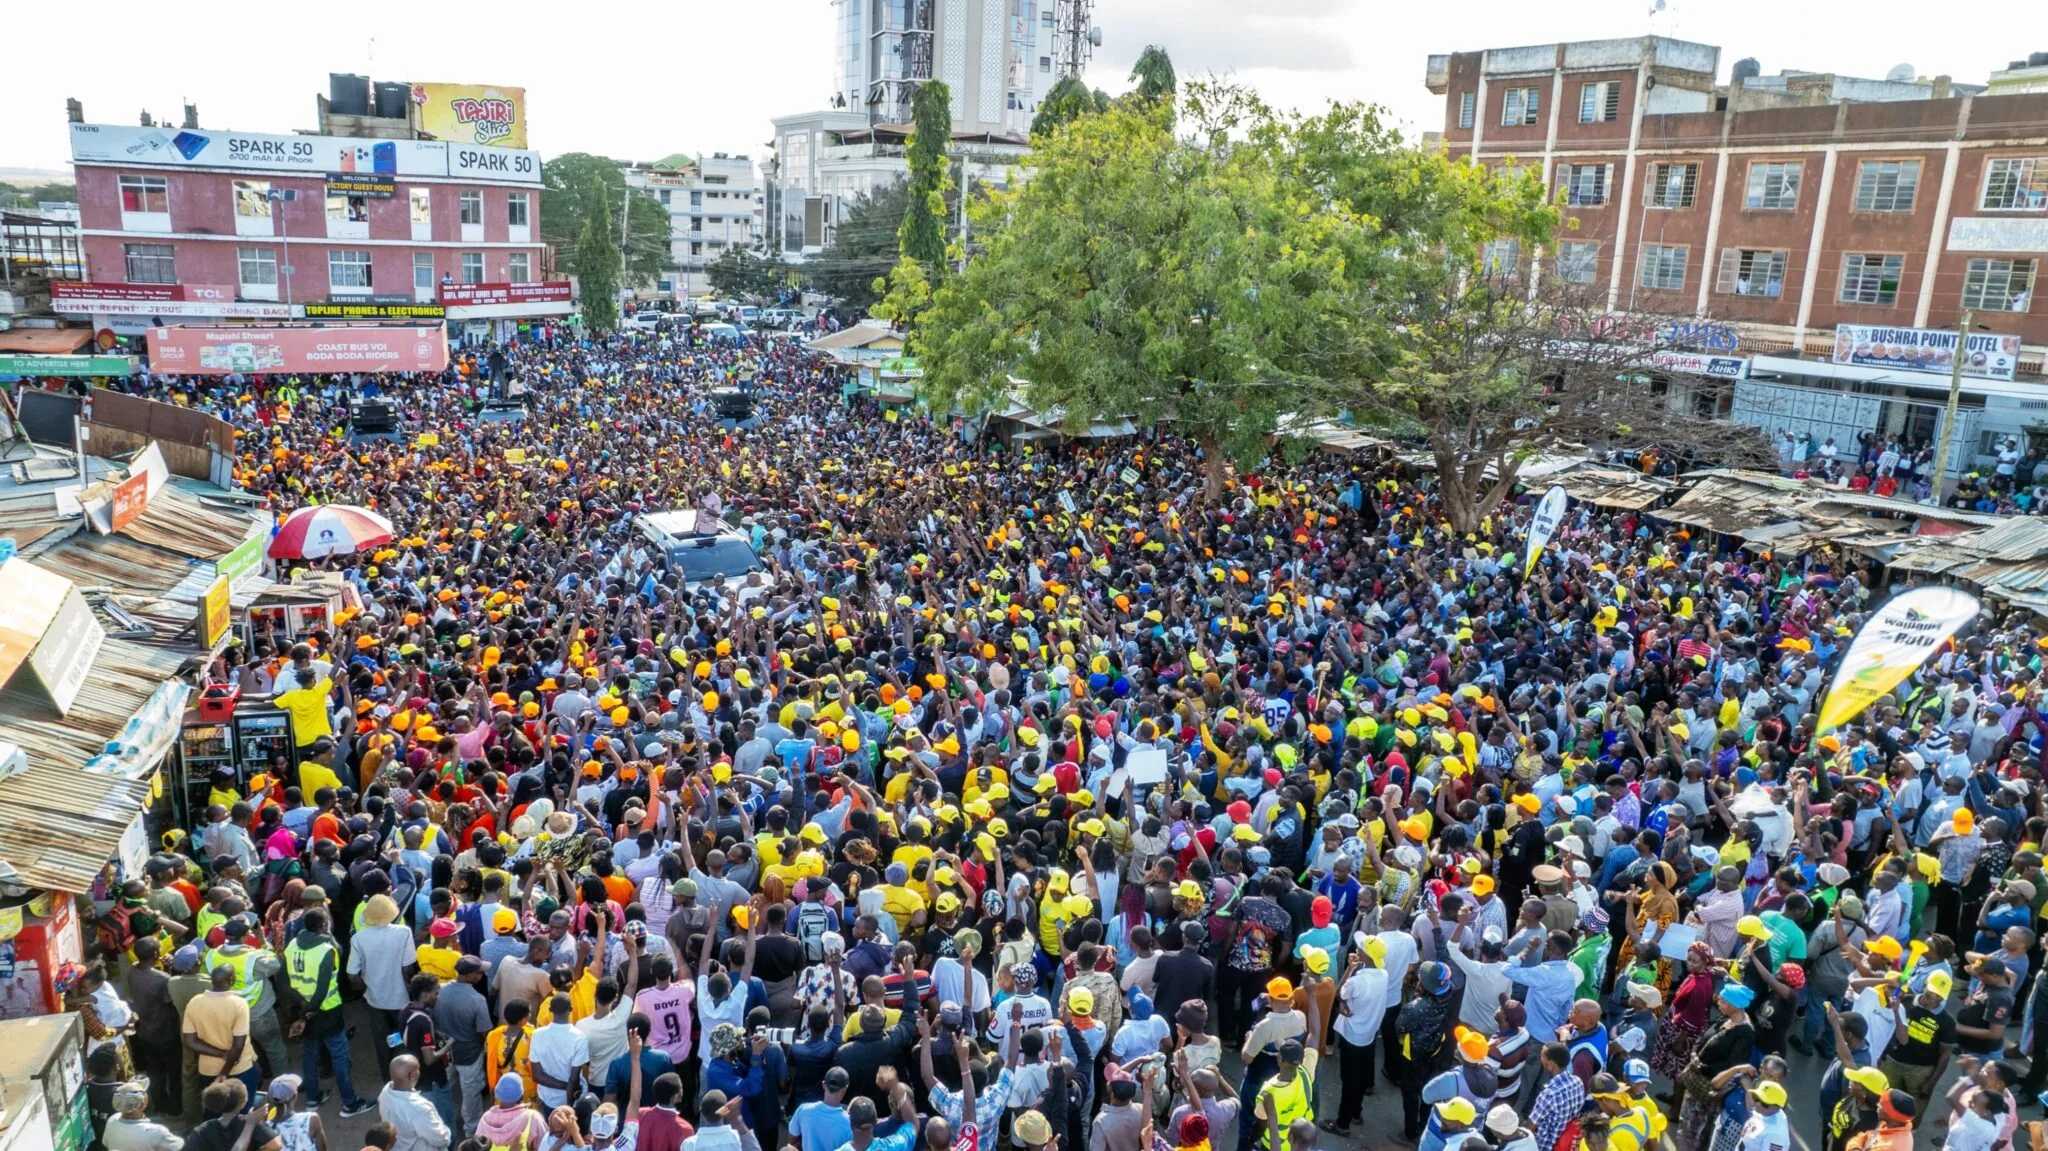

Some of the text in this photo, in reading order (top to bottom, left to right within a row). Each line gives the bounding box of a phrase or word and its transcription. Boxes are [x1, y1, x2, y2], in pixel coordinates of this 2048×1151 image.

[475, 121, 511, 145] Slice
[229, 139, 313, 155] SPARK 50
[287, 156, 313, 164] Phone
[460, 151, 532, 173] SPARK 50
[193, 289, 224, 299] TCL
[148, 305, 181, 313] JESUS
[306, 306, 444, 316] TOPLINE PHONES & ELECTRONICS
[206, 332, 274, 341] Mapishi Shwari
[1871, 329, 1918, 346] BUSHRA
[1921, 333, 1958, 348] POINT
[316, 343, 387, 351] COAST BUS VOI
[306, 351, 399, 360] BODA BODA RIDERS
[1708, 364, 1737, 375] 24HRS
[1265, 706, 1287, 727] 85
[664, 1012, 680, 1037] 9
